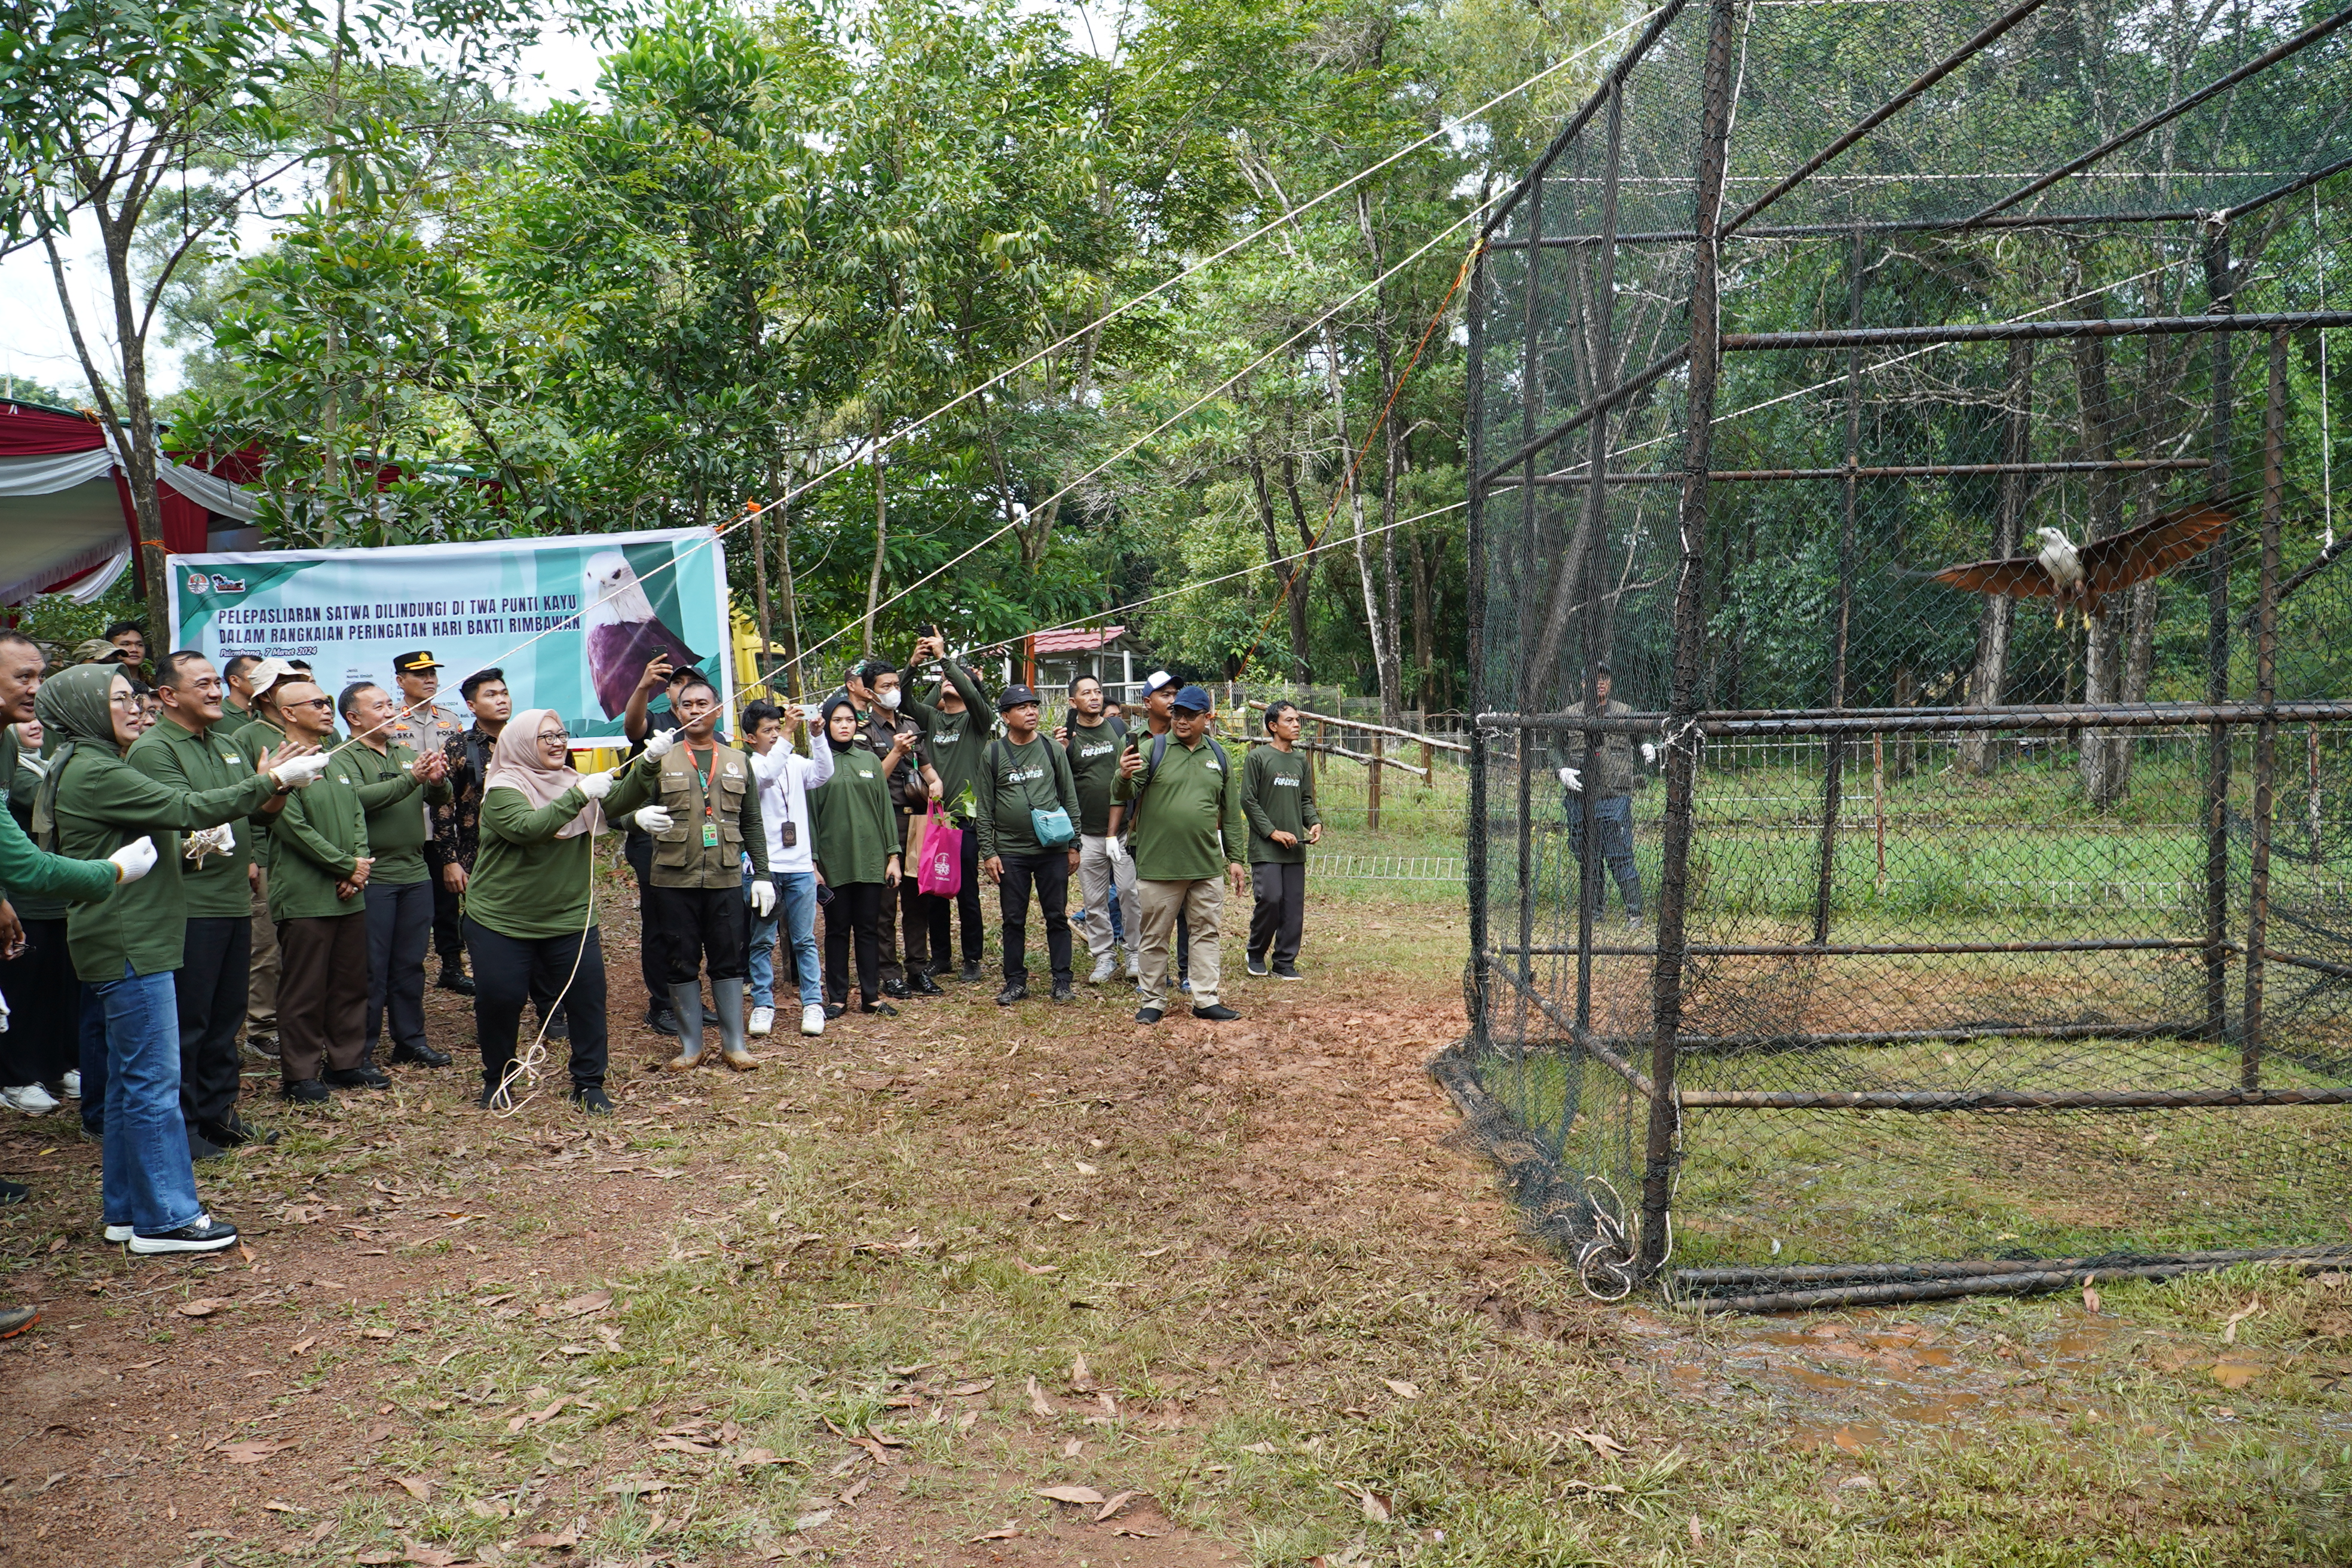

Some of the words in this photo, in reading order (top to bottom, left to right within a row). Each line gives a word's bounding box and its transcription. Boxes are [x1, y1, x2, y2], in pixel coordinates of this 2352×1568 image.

[219, 607, 321, 624] PELEPASLIARAN
[326, 605, 370, 621] SATWA
[375, 601, 446, 619] DILINDUNGI
[452, 601, 464, 615] DI
[470, 599, 496, 614] TWA
[502, 596, 538, 613] PUNTI
[544, 594, 577, 611] KAYU
[219, 628, 265, 644] DALAM
[271, 626, 344, 643] RANGKAIAN
[349, 622, 427, 640] PERINGATAN
[433, 620, 462, 636] HARI
[467, 618, 503, 635] BAKTI
[509, 614, 581, 633] RIMBAWAN
[265, 648, 272, 657] 7
[272, 647, 296, 656] Maret
[297, 646, 317, 655] 2024
